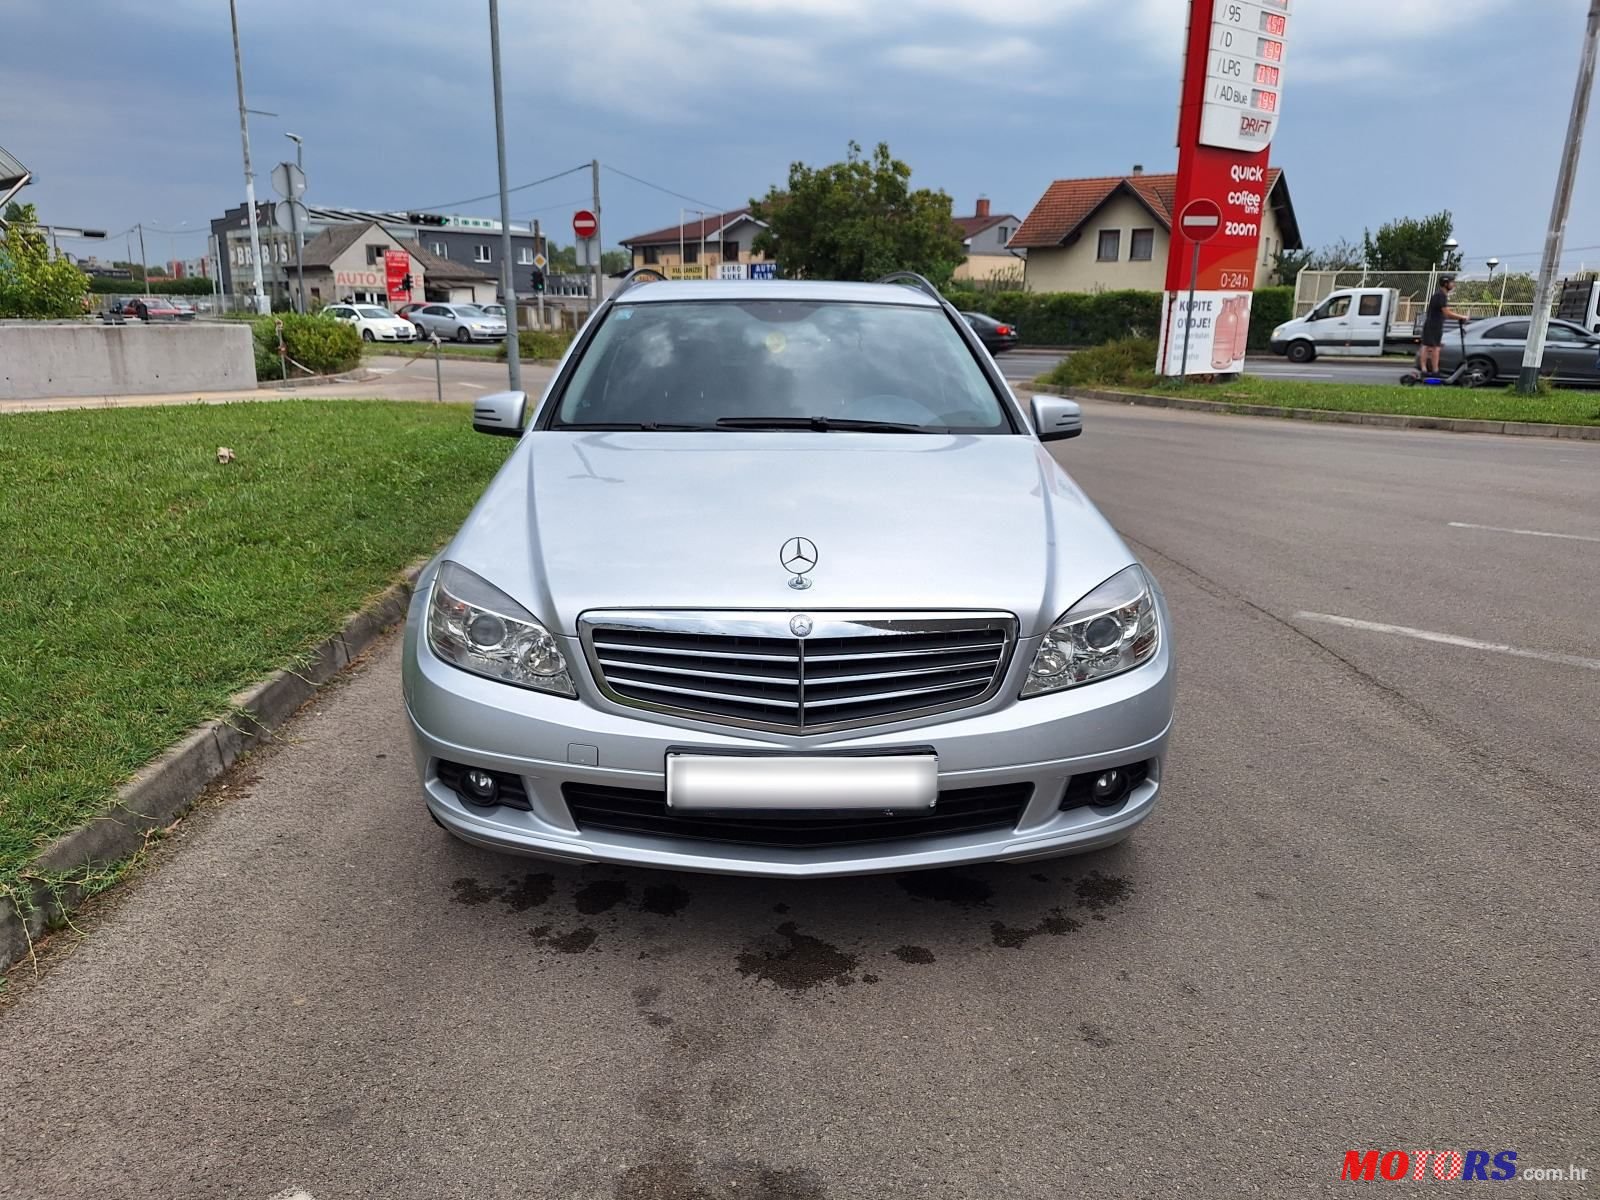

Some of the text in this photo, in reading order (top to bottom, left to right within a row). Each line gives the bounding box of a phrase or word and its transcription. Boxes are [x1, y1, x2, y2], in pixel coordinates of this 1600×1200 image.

[1241, 116, 1271, 134] DRIFT
[1228, 190, 1260, 206] coffee
[756, 264, 777, 272] AUTO
[336, 271, 377, 286] AUTO
